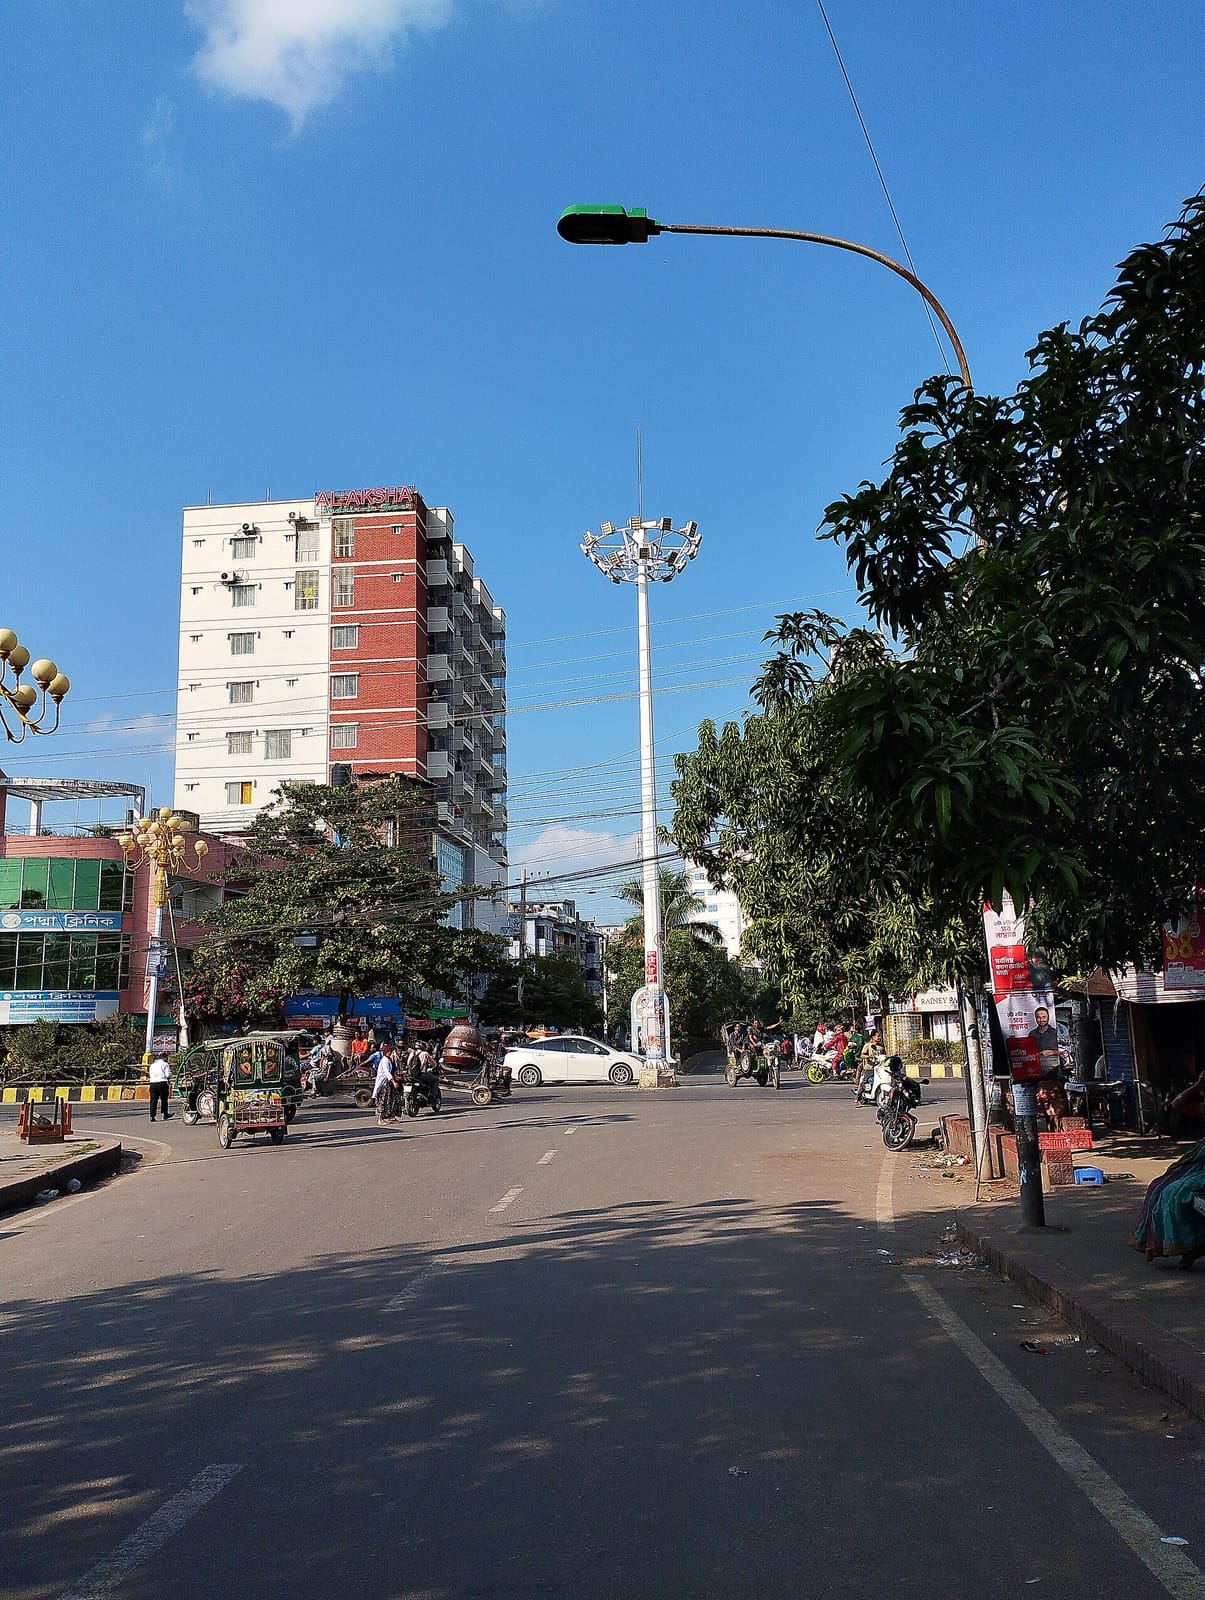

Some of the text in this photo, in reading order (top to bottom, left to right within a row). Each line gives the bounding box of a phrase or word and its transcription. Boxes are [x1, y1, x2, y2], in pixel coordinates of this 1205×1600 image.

[316, 486, 412, 506] AL-AKSHA
[24, 914, 115, 928] পদ্মা ক্লিনিক
